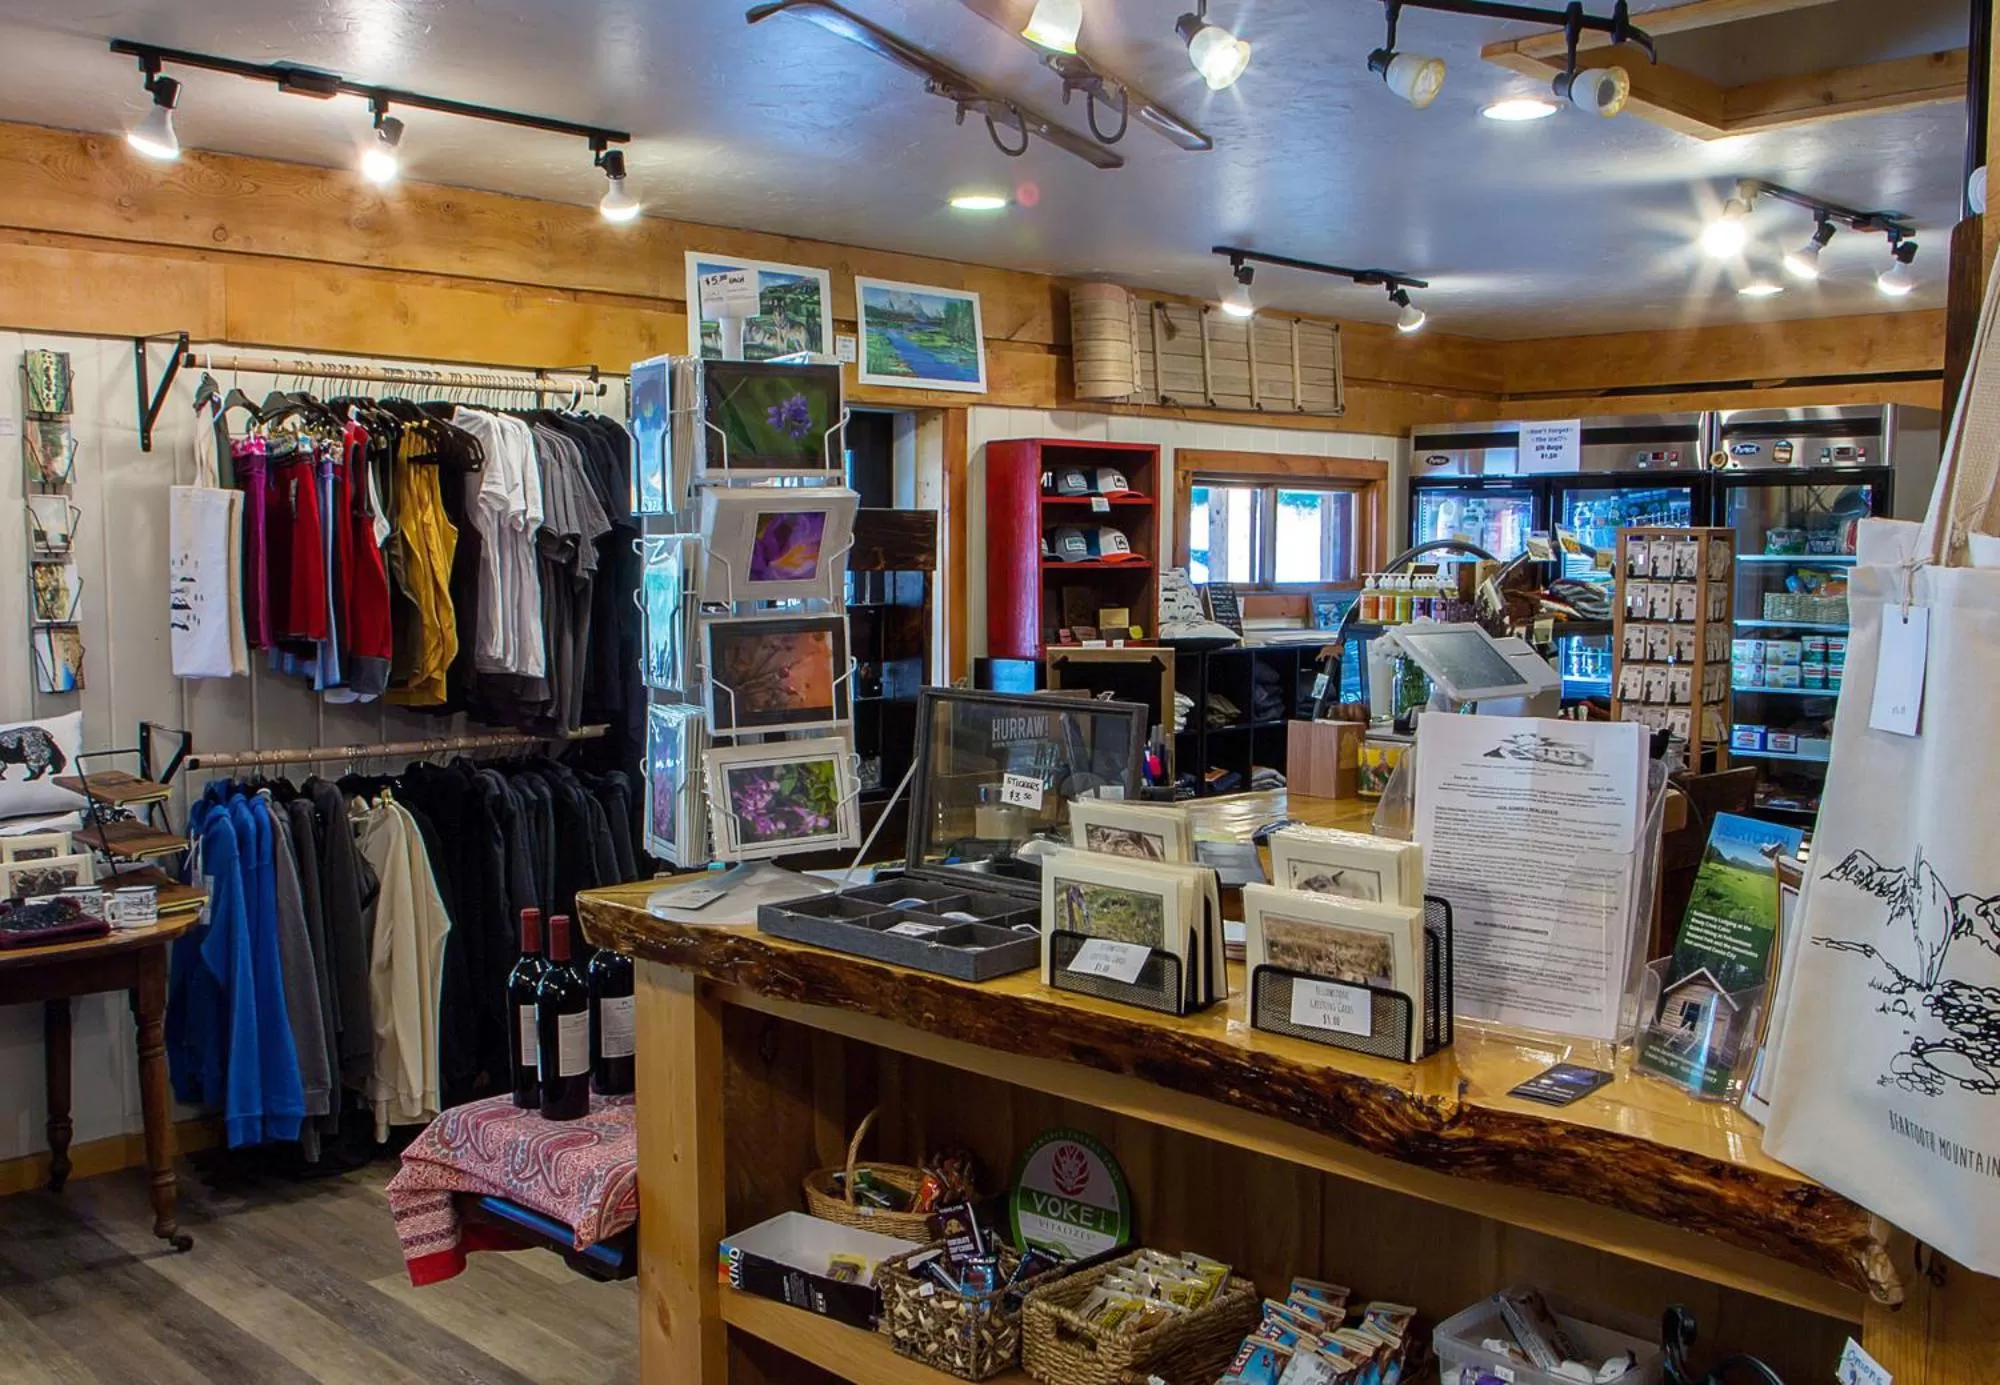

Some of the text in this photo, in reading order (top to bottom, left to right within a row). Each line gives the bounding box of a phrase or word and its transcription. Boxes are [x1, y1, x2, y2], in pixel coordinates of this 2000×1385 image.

[992, 716, 1049, 741] HURRAW!
[1007, 776, 1040, 792] STICKERS
[1032, 1191, 1094, 1227] VOKE
[728, 1247, 741, 1290] KIND
